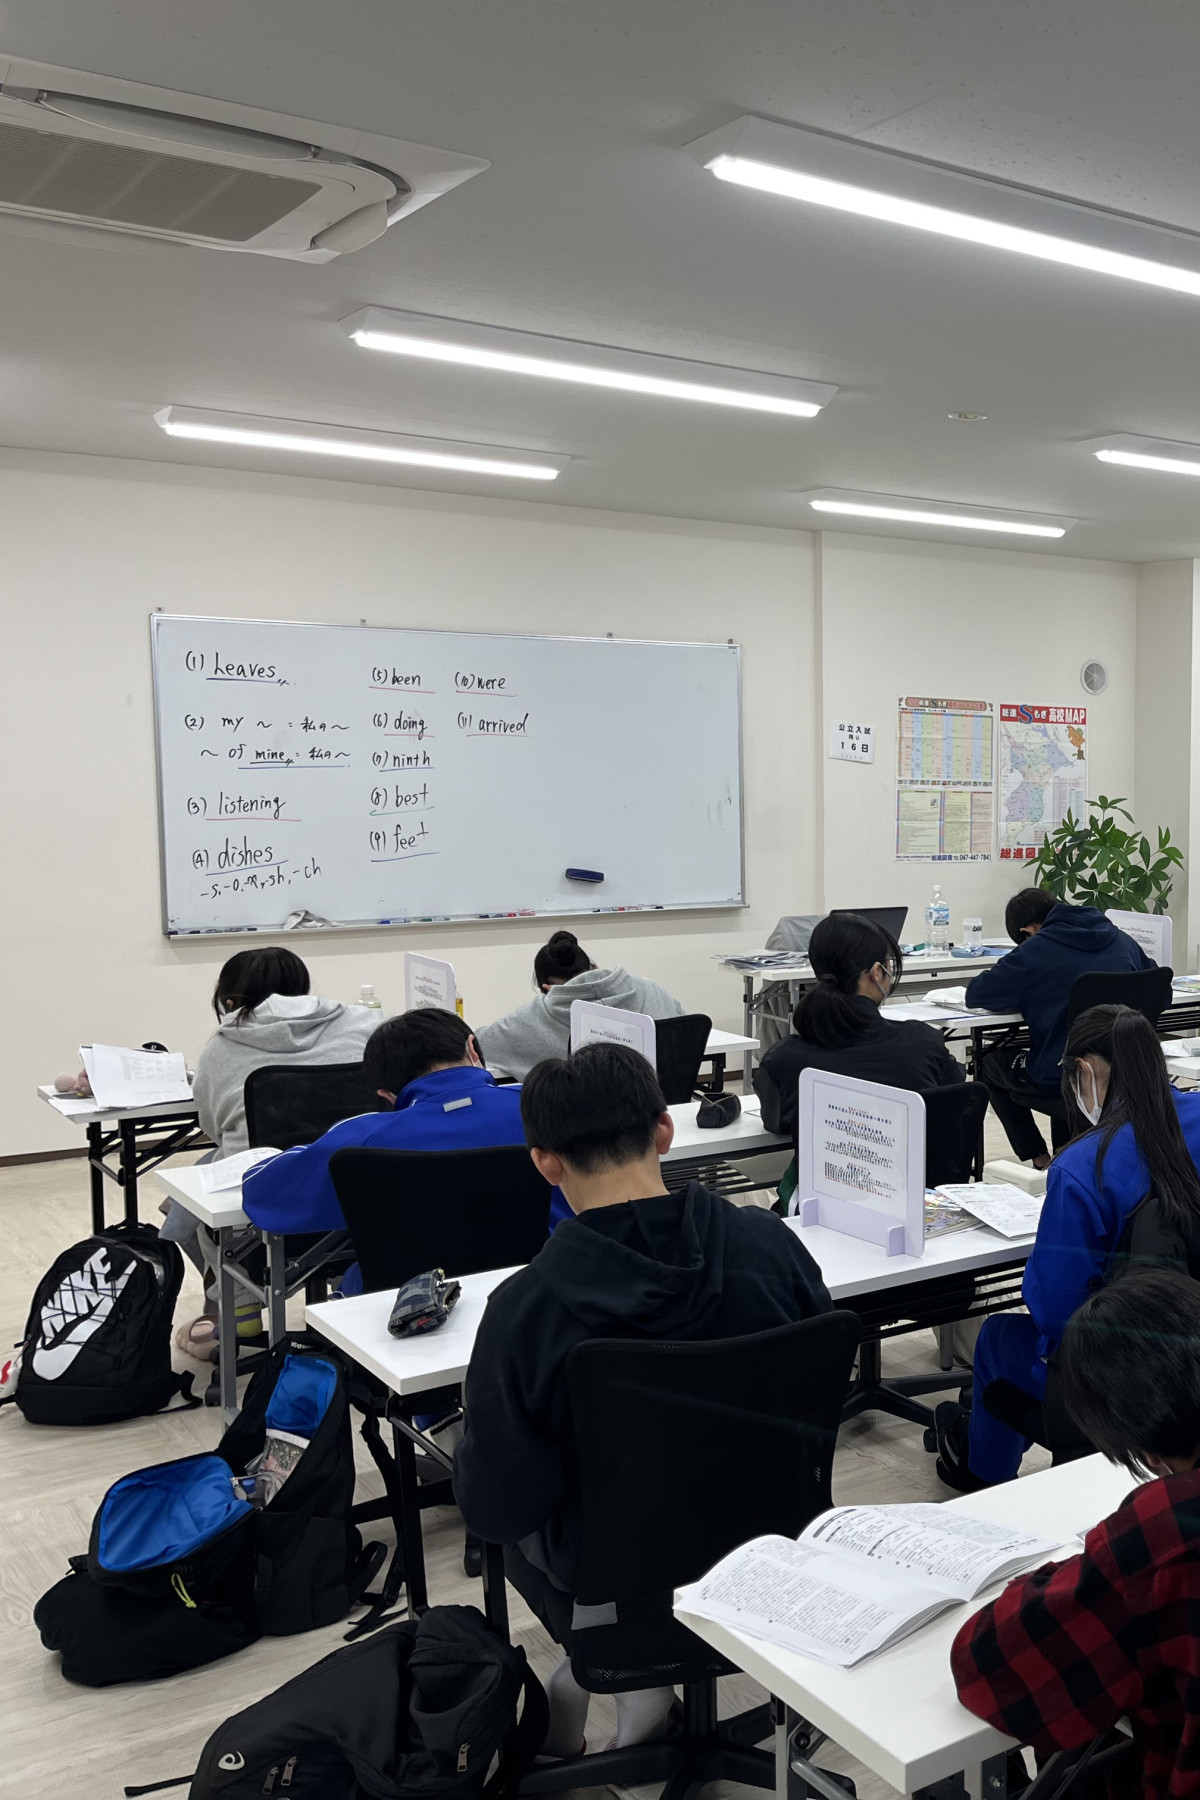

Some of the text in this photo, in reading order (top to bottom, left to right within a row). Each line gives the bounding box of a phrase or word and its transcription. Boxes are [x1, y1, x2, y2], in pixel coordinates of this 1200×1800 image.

[372, 667, 421, 687] (5) been
[477, 676, 506, 690] were
[184, 715, 204, 731] (2)
[222, 716, 244, 733] my
[373, 710, 428, 741] (6) doing
[478, 713, 530, 733] arrived
[229, 744, 247, 760] of
[255, 749, 285, 761] mine
[393, 750, 430, 768] ninth
[187, 792, 286, 820] (3) listening
[371, 783, 428, 809] (8) best
[369, 822, 430, 853] (9) feet
[218, 836, 273, 869] dishes
[41, 1247, 111, 1346] NIKE
